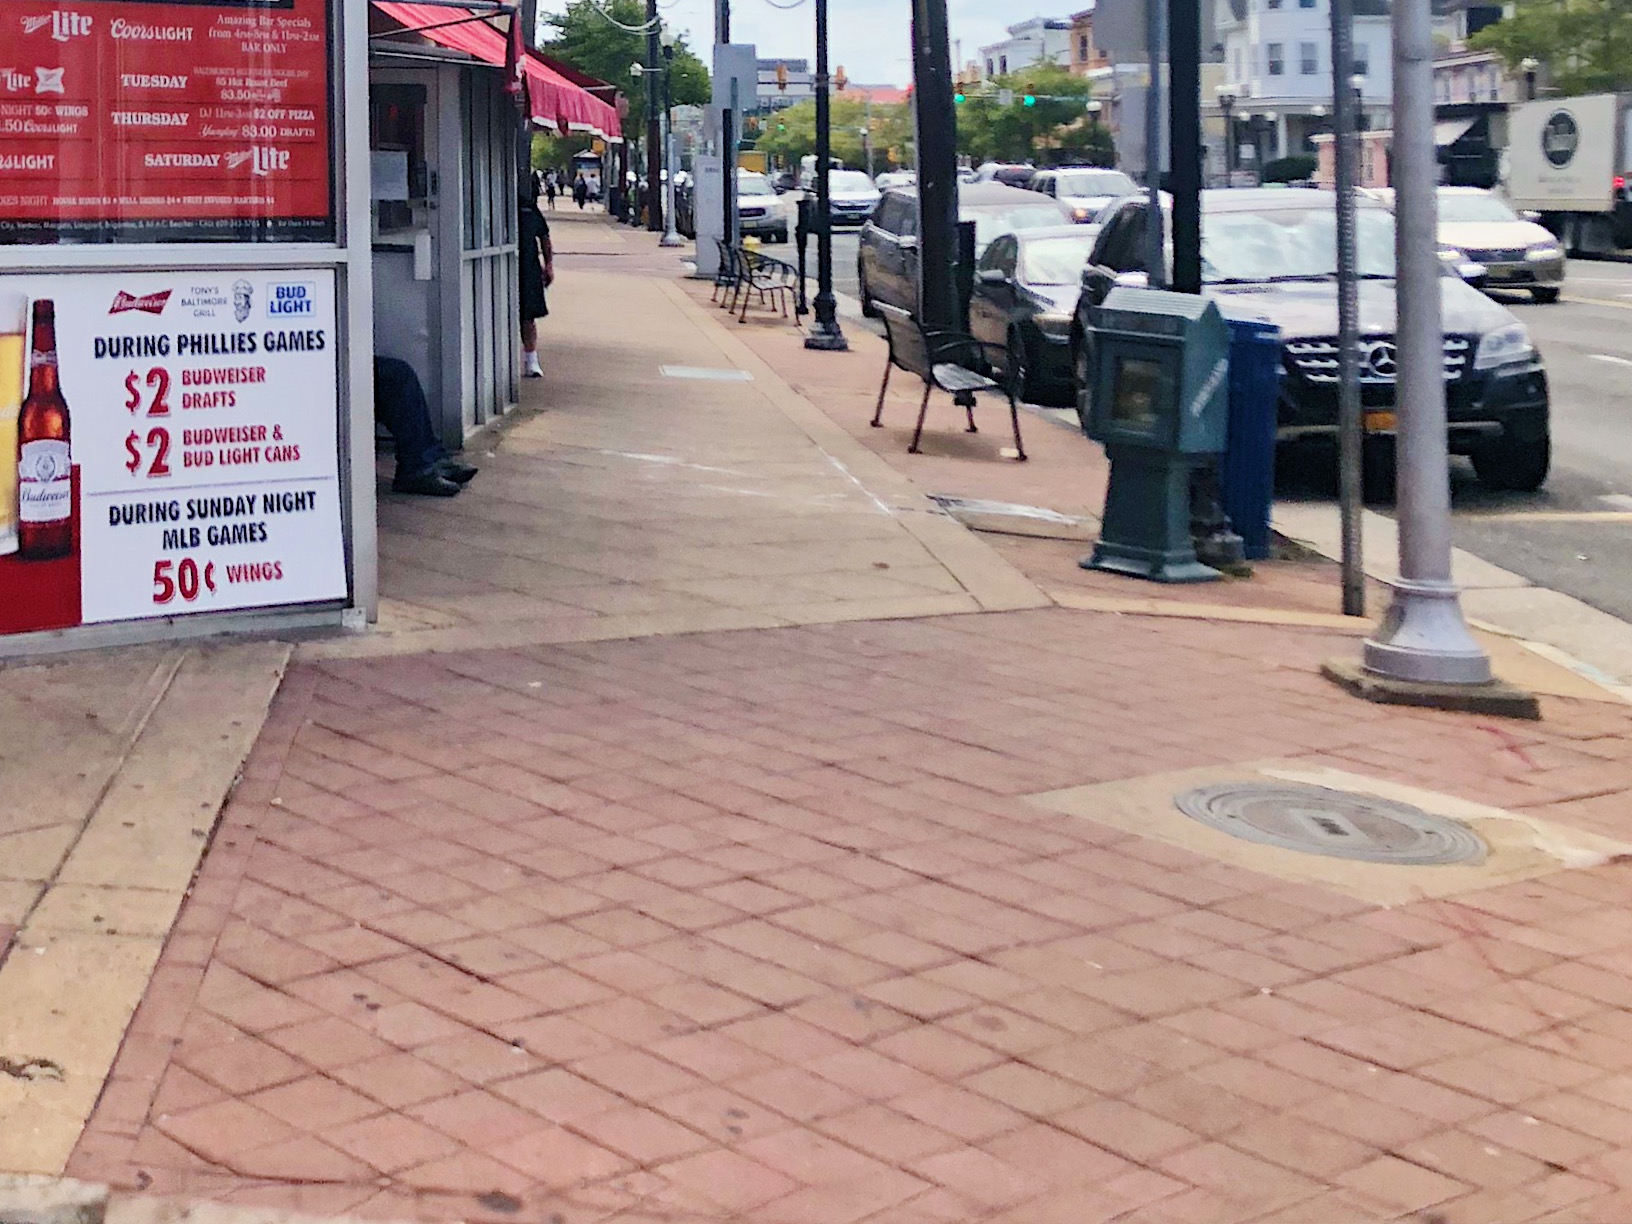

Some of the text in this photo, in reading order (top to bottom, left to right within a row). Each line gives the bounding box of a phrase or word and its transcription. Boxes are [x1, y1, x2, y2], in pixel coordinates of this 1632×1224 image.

[51, 10, 93, 41] Lite
[110, 18, 194, 41] Coors LIGHT
[6, 69, 32, 92] Lite
[121, 74, 188, 89] TUESDAY
[1, 104, 32, 116] NIGHT
[55, 106, 89, 117] WINGS
[111, 111, 189, 126] THURSDAY
[288, 109, 315, 121] PIZZA
[14, 154, 55, 170] LIGHT
[144, 153, 221, 167] SATURDAY
[252, 145, 290, 176] Lite
[20, 196, 48, 206] NIGHT
[276, 286, 306, 299] BUD
[269, 300, 313, 314] LIGHT
[94, 330, 325, 359] DURING PHILLIES GAMES
[182, 366, 266, 386] BUDWEISER
[125, 366, 171, 417] $2
[182, 391, 236, 409] DRAFTS
[183, 424, 284, 445] BUDWEISER &
[125, 426, 172, 478] $2
[183, 445, 301, 468] BUD LIGHT CANS
[109, 491, 317, 526] DURING SUNDAY NIGHT
[162, 522, 268, 550] MLB GAMES
[226, 561, 283, 584] WINGS
